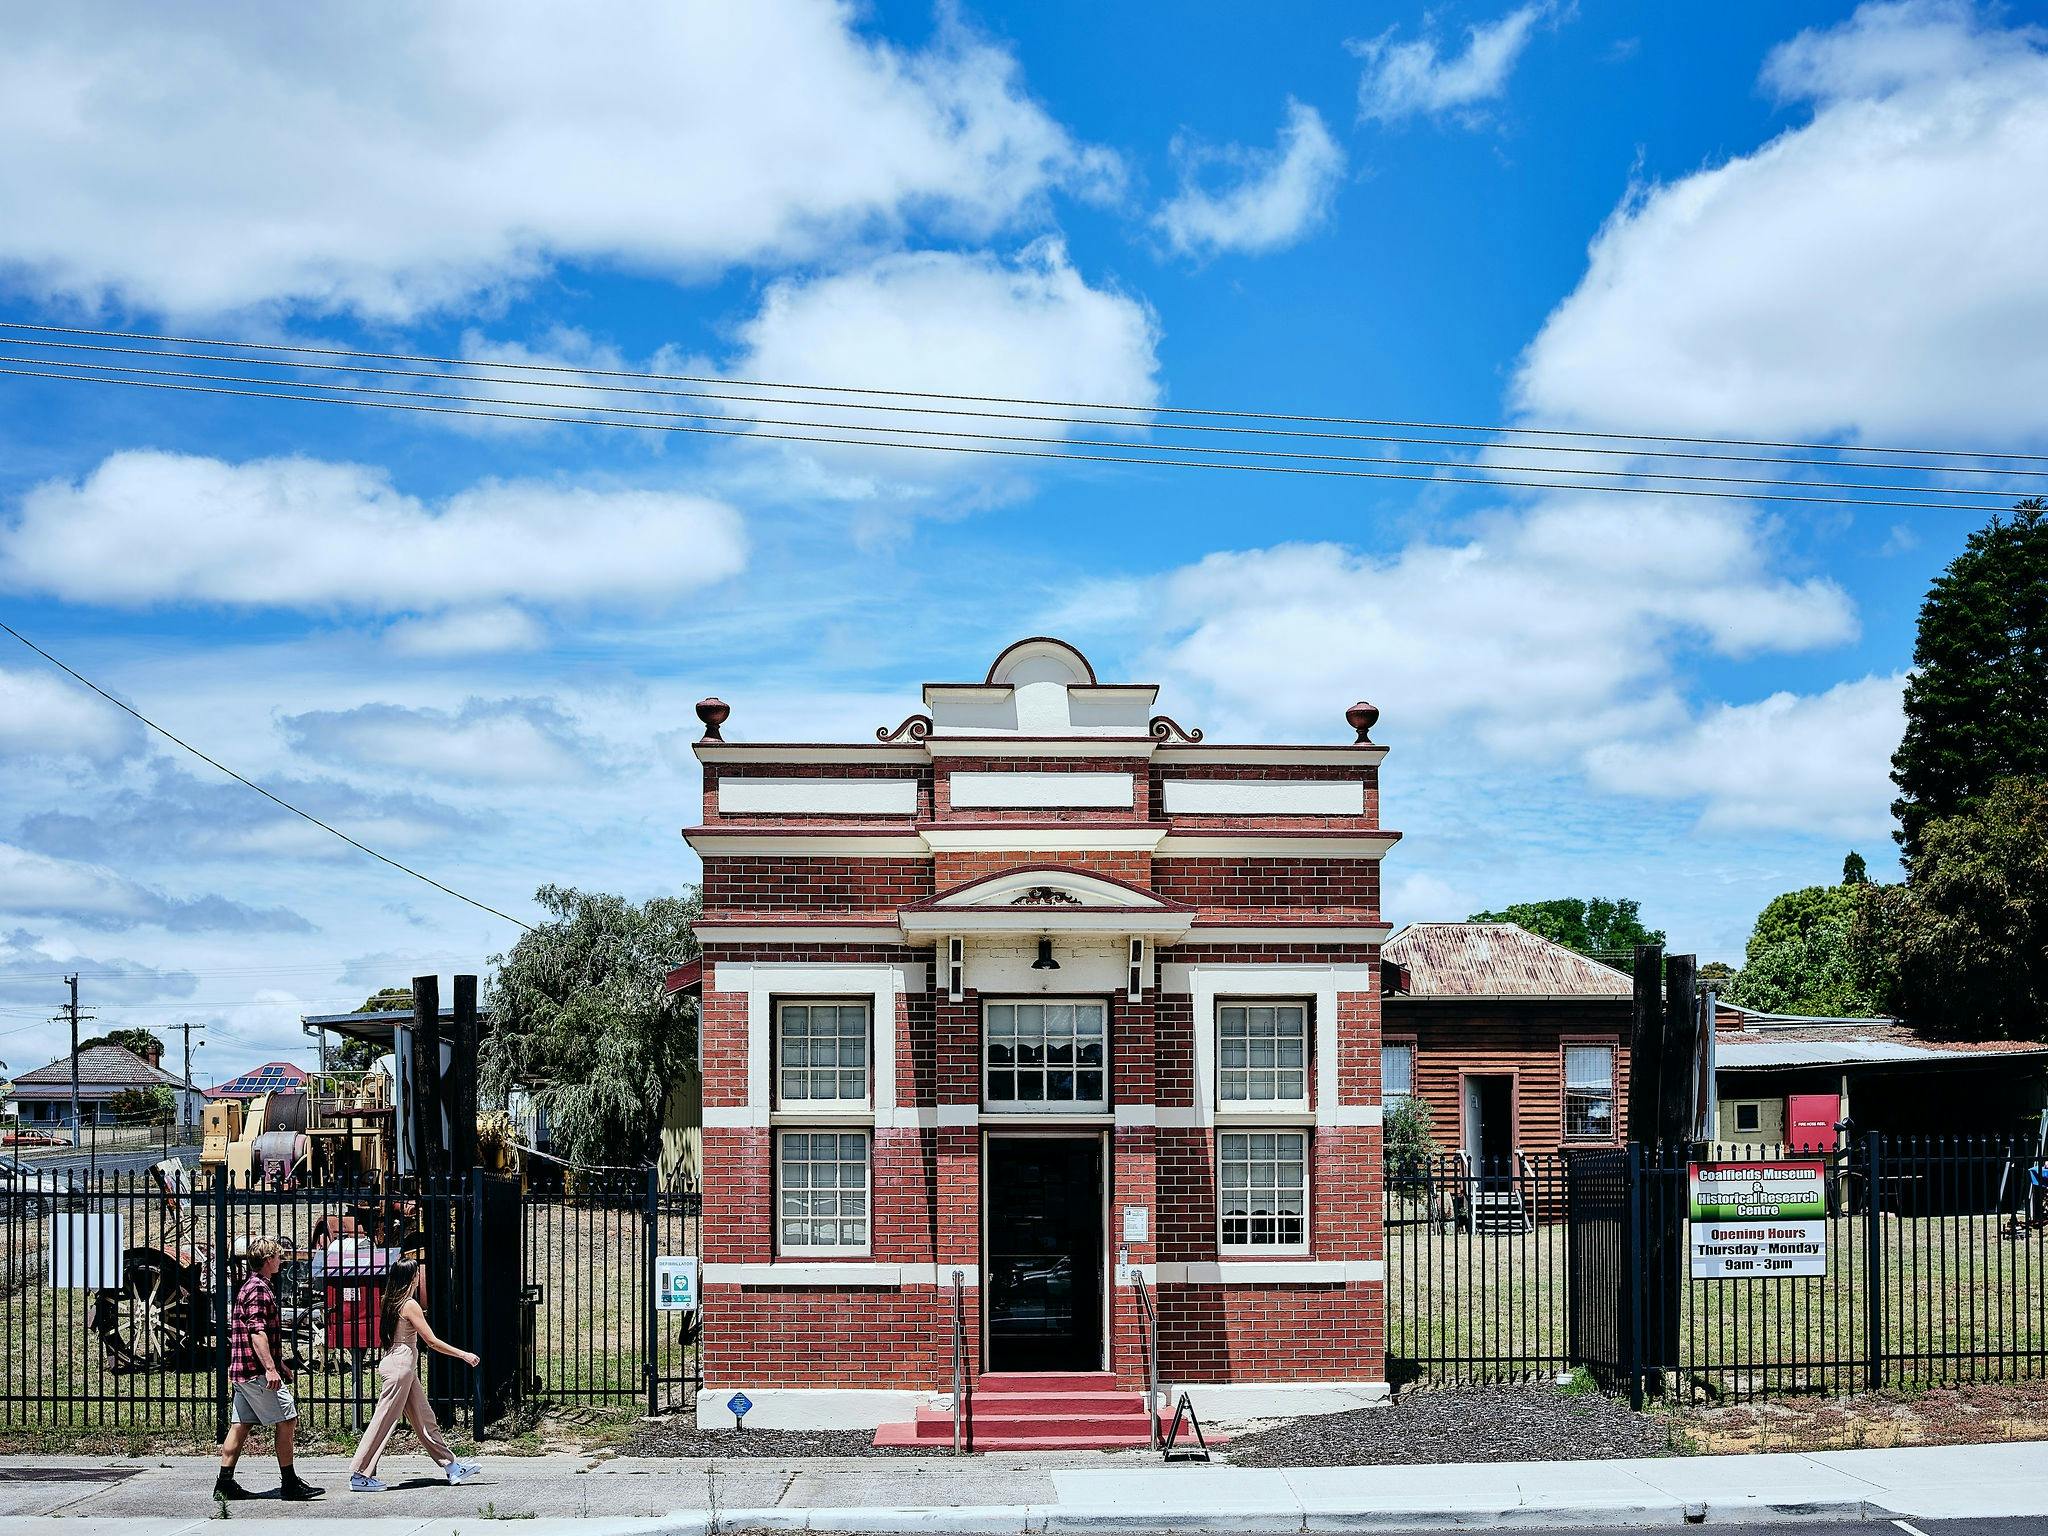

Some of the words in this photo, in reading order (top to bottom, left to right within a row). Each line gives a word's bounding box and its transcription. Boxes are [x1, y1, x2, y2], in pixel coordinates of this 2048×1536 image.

[1699, 1169, 1761, 1181] Coalfields
[1763, 1168, 1816, 1180] Museum
[1752, 1182, 1763, 1192] &
[1698, 1193, 1758, 1205] Historical
[1760, 1191, 1818, 1204] Research
[1737, 1205, 1779, 1216] Centre
[1711, 1229, 1765, 1240] Opening
[1768, 1228, 1806, 1239] Hours
[1698, 1244, 1758, 1256] Thursday
[1769, 1243, 1819, 1254] Monday
[1725, 1259, 1753, 1270] 9am
[1764, 1258, 1793, 1270] 3pm
